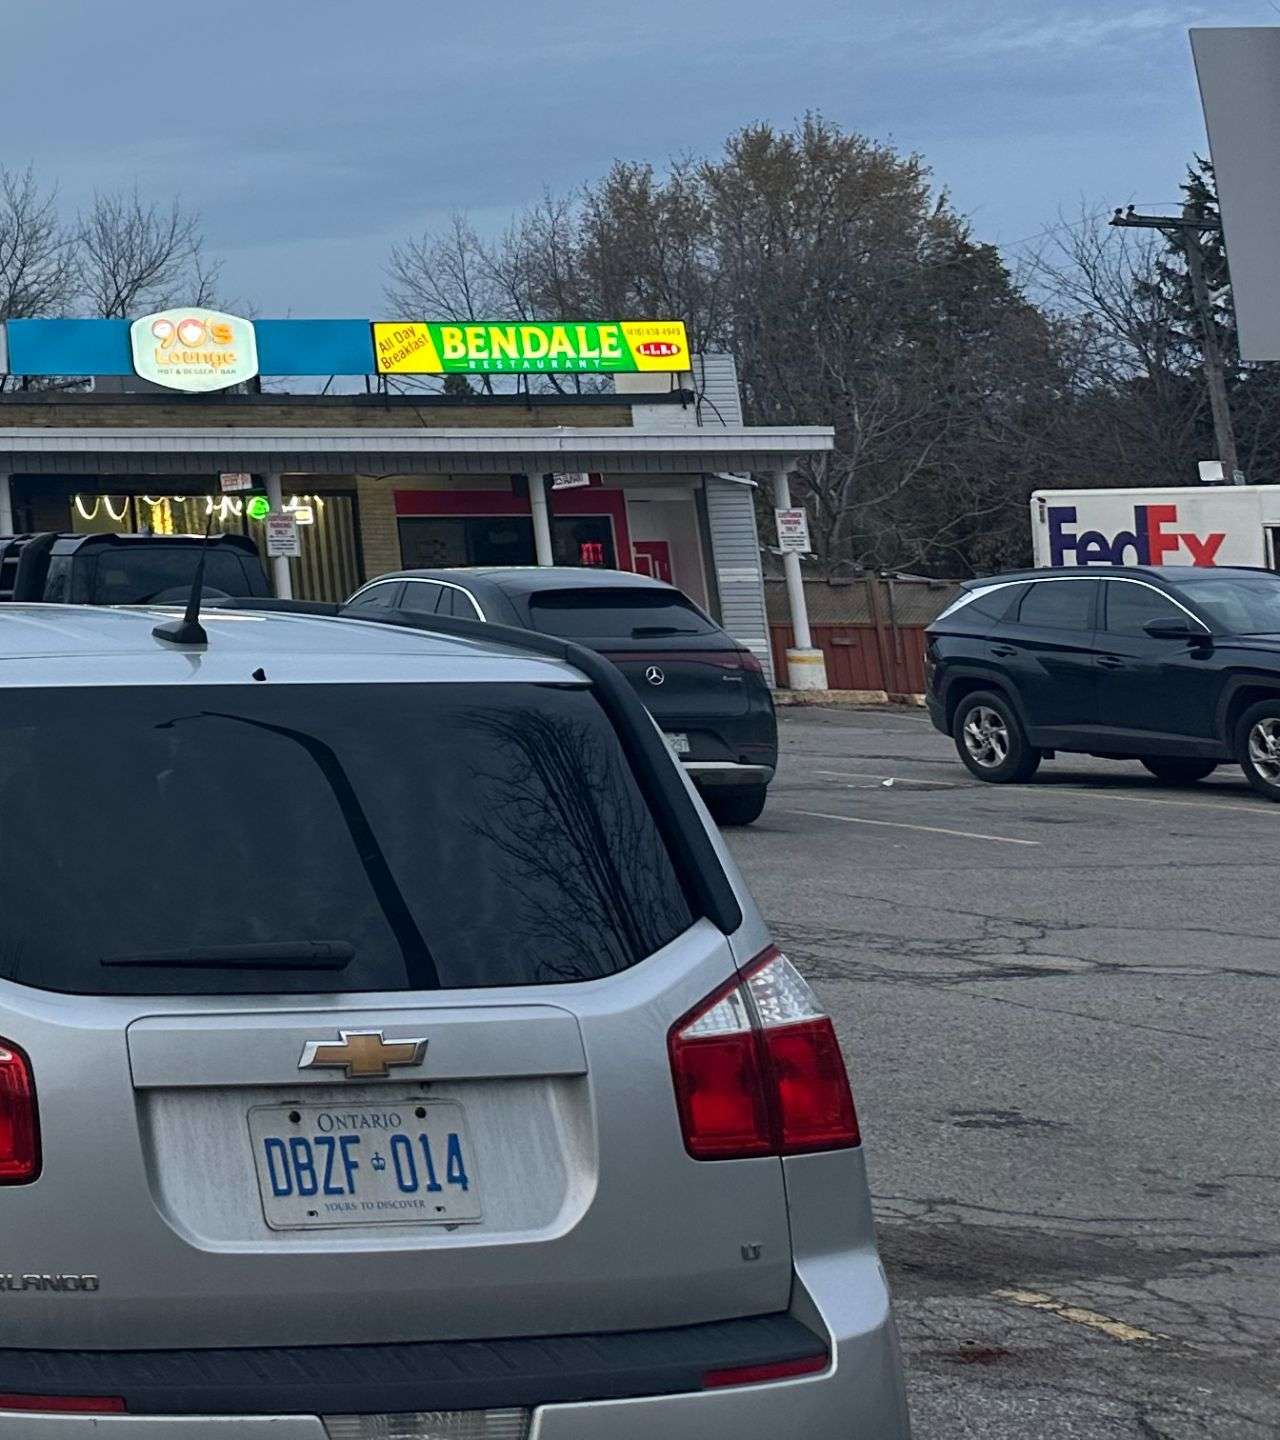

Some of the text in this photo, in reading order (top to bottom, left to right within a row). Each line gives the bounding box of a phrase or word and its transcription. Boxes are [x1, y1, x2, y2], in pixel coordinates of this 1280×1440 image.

[379, 326, 416, 354] All Day
[381, 334, 430, 369] Breakfast
[441, 324, 623, 360] BENDALE
[155, 348, 237, 368] Lounge
[469, 360, 602, 369] RESTAURANT
[1047, 504, 1226, 567] FedEx
[317, 1112, 402, 1133] ONTARIO
[324, 1199, 426, 1212] YOURS TO DISCOVER
